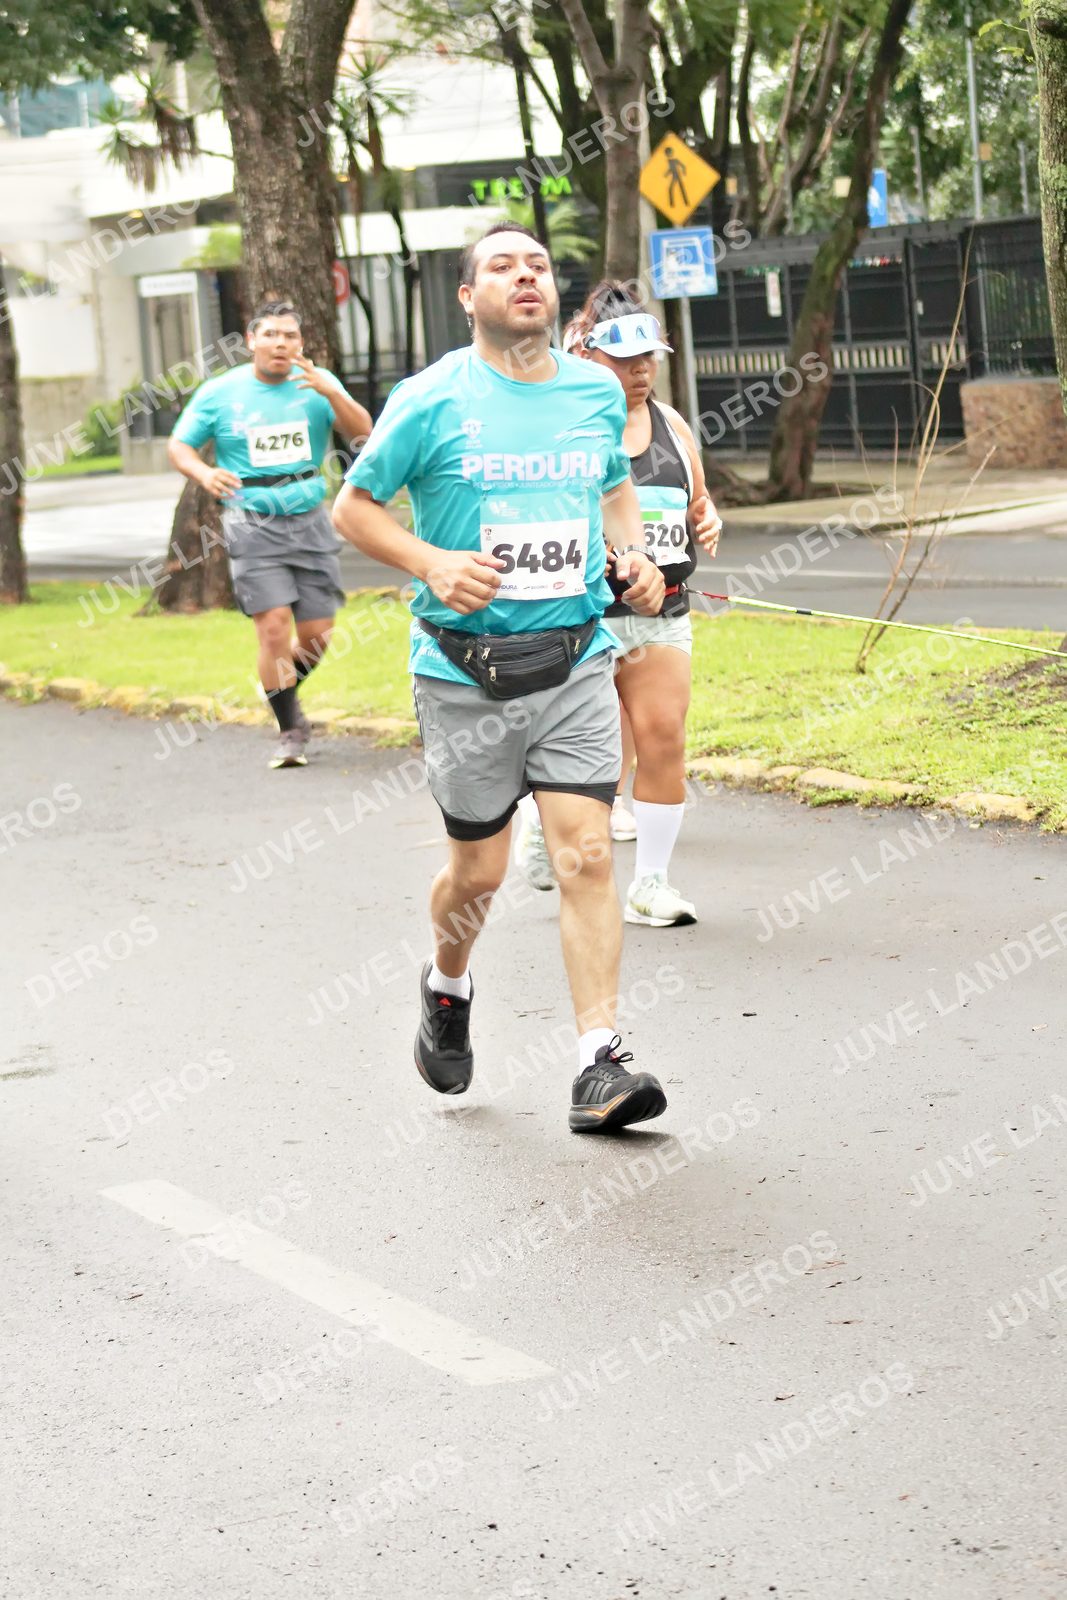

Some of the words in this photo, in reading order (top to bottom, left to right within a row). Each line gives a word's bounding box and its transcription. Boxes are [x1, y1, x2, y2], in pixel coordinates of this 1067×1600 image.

[255, 432, 304, 452] 4276
[461, 451, 601, 481] PERDURA
[492, 539, 582, 575] 6484
